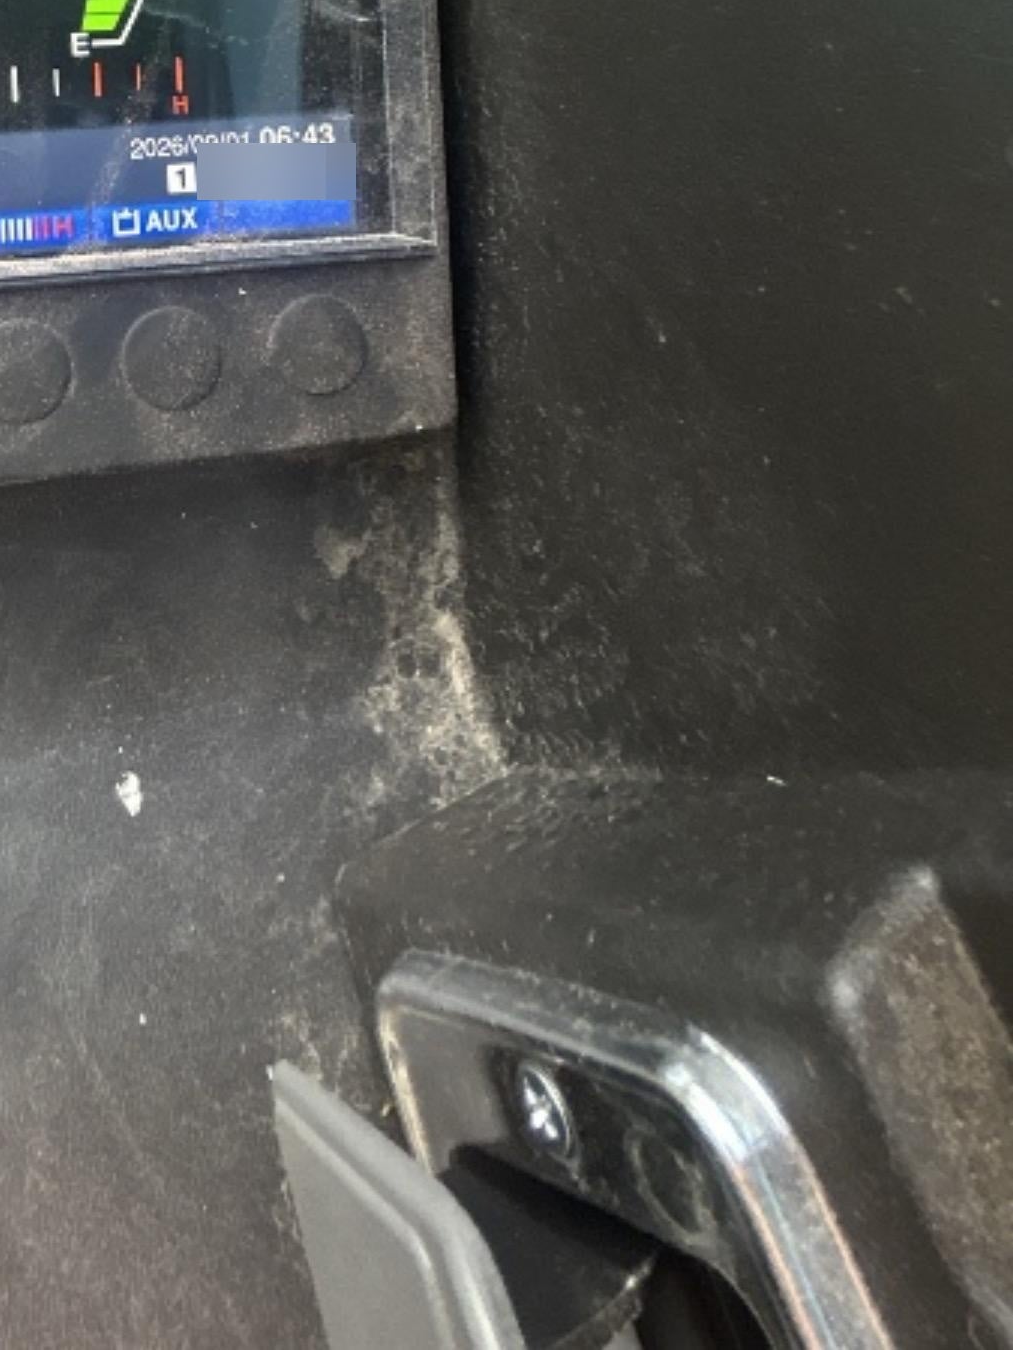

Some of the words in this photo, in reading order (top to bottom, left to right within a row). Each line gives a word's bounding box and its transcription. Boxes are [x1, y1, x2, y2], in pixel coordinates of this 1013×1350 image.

[70, 32, 90, 58] E
[172, 95, 189, 115] H
[175, 167, 187, 190] 1
[146, 206, 199, 233] AUX
